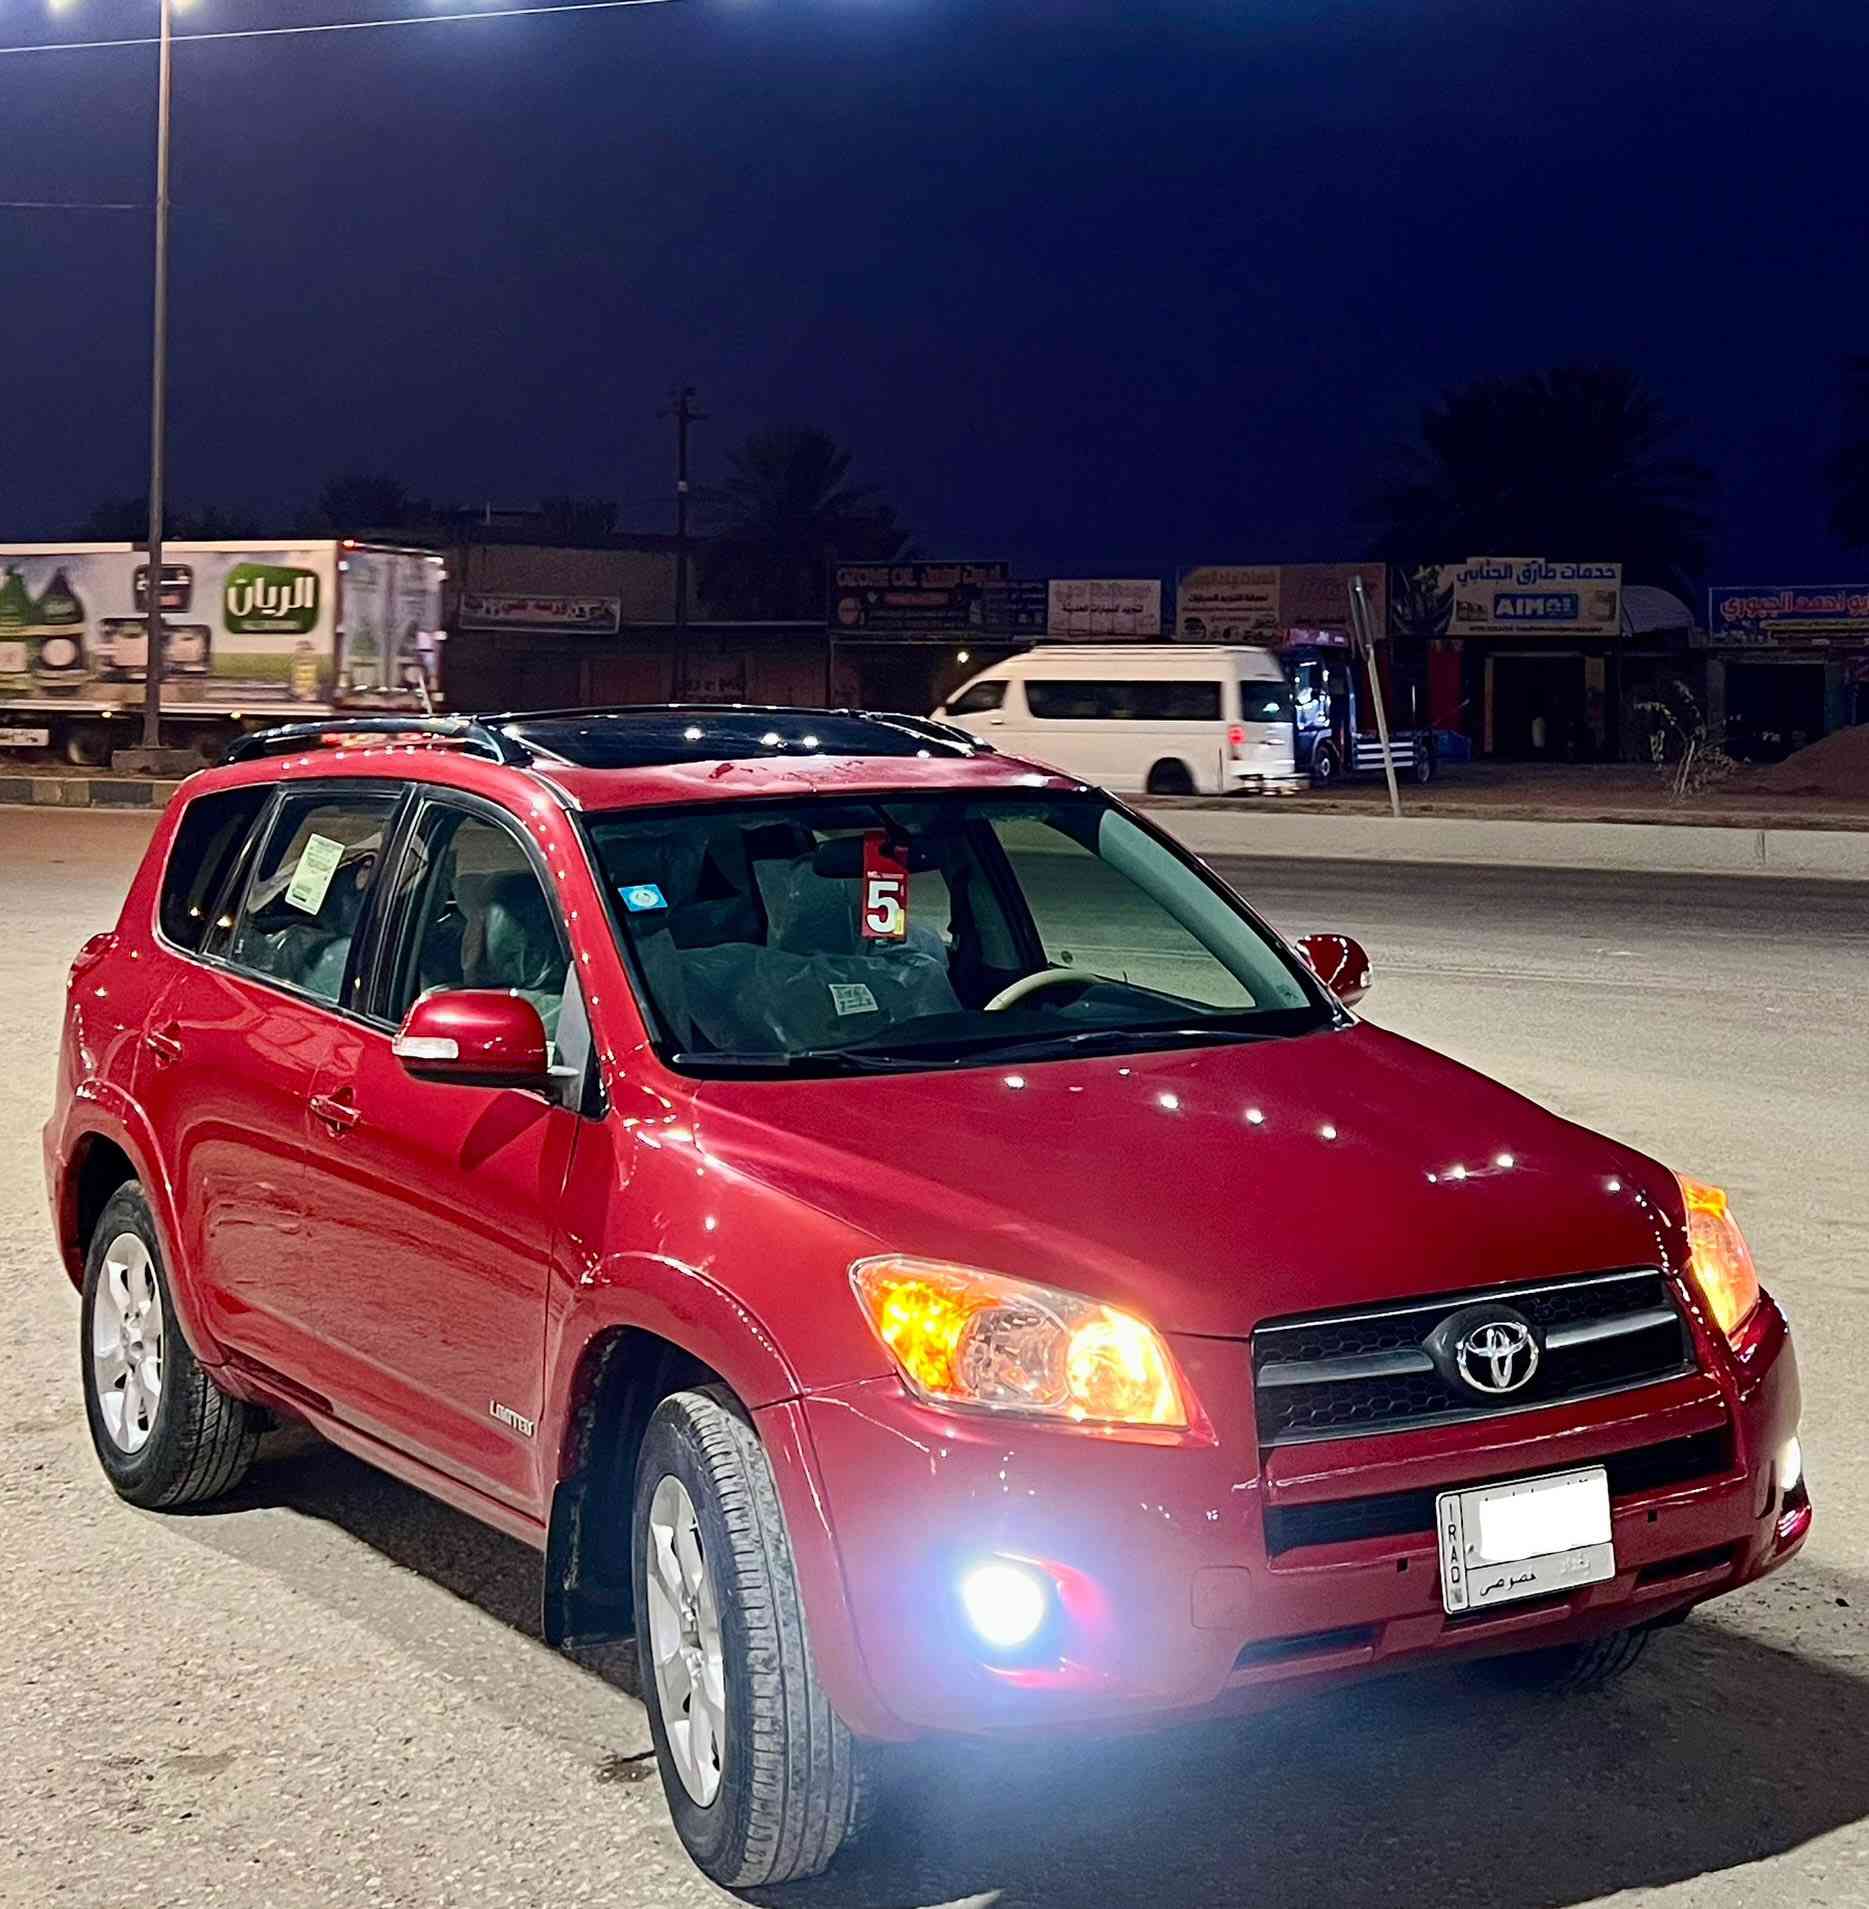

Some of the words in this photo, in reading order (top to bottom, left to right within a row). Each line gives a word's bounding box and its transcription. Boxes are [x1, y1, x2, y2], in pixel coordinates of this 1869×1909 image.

[1561, 563, 1616, 580] خدمات
[227, 576, 315, 617] الريان
[866, 880, 900, 933] 5
[1447, 1503, 1461, 1584] IRAQ
